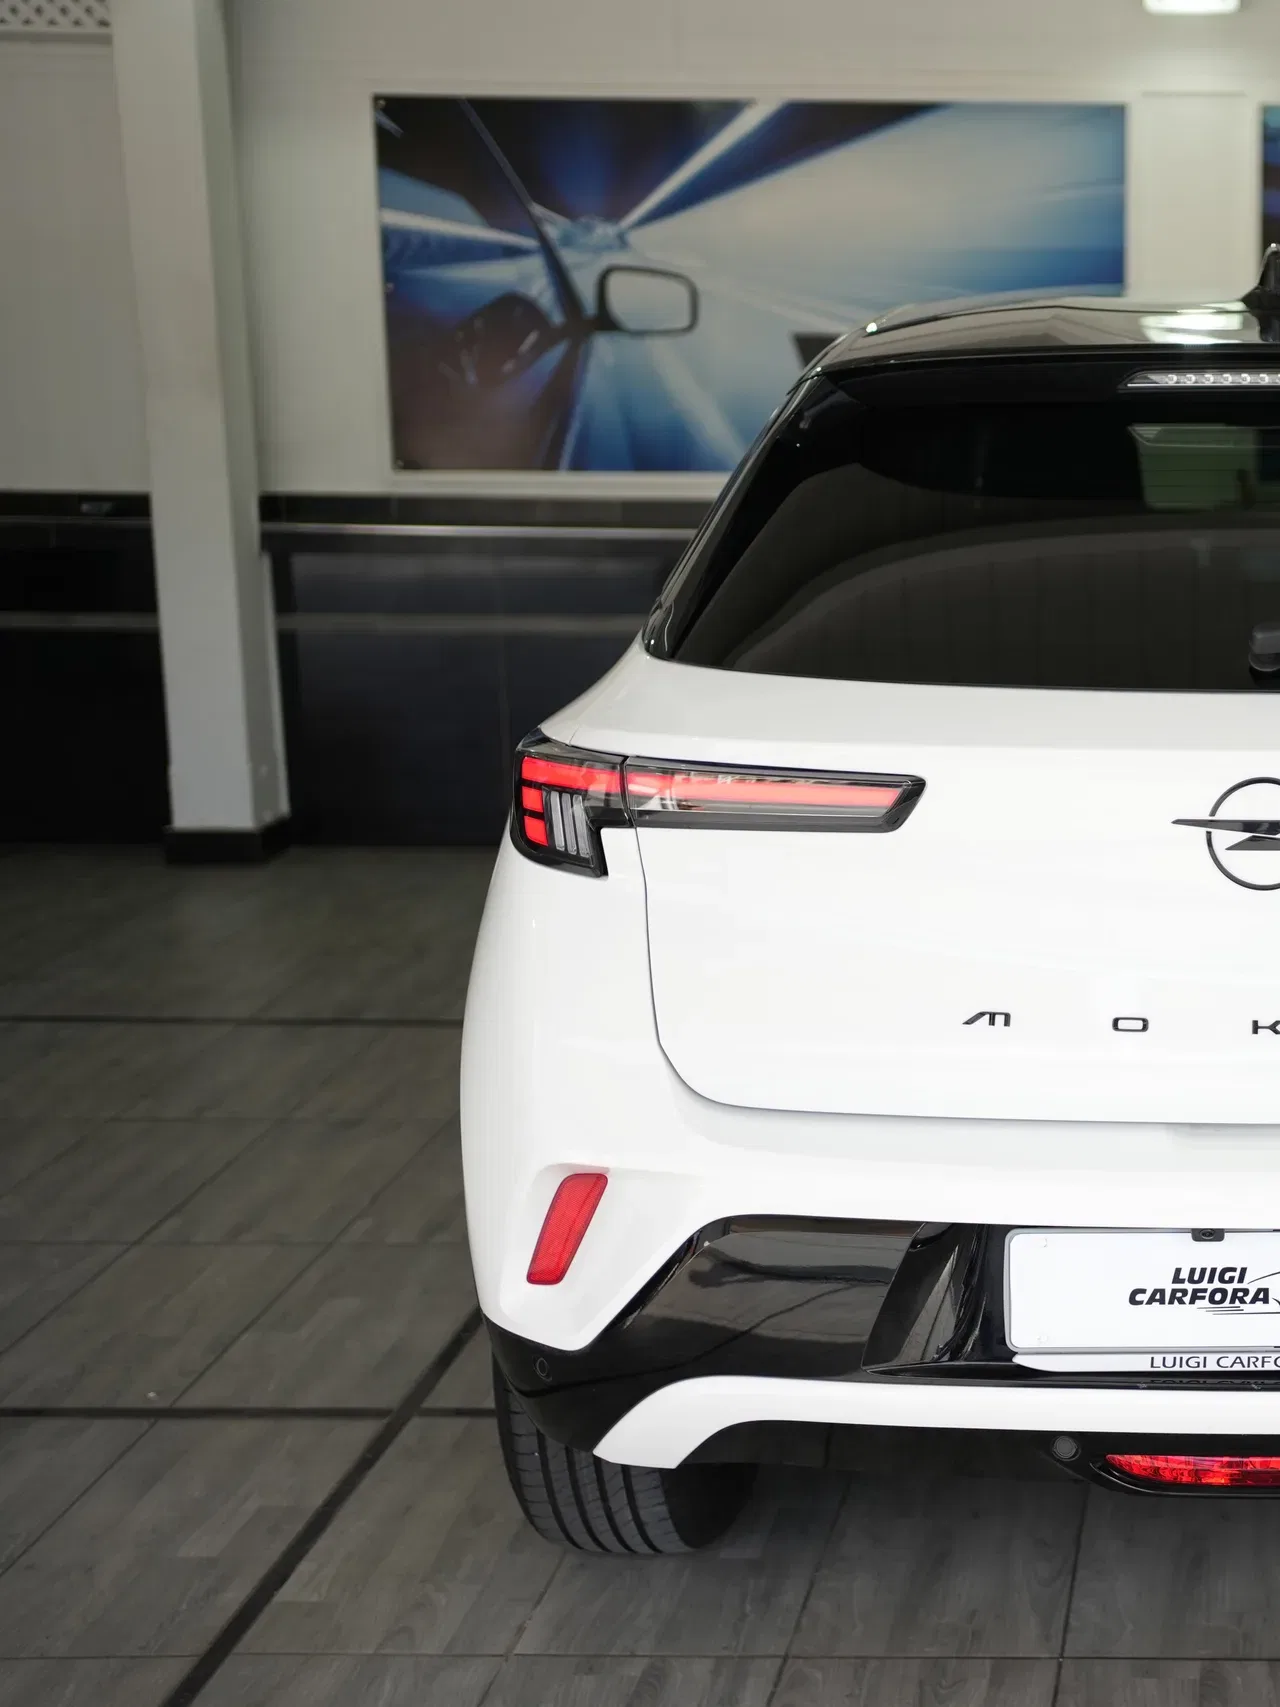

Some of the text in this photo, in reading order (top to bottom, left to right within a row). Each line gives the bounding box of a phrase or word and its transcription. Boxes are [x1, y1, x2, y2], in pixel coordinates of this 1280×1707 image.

[1171, 1266, 1248, 1285] LUIGI
[1128, 1287, 1270, 1306] CARFORA
[1150, 1355, 1208, 1369] LUIGI
